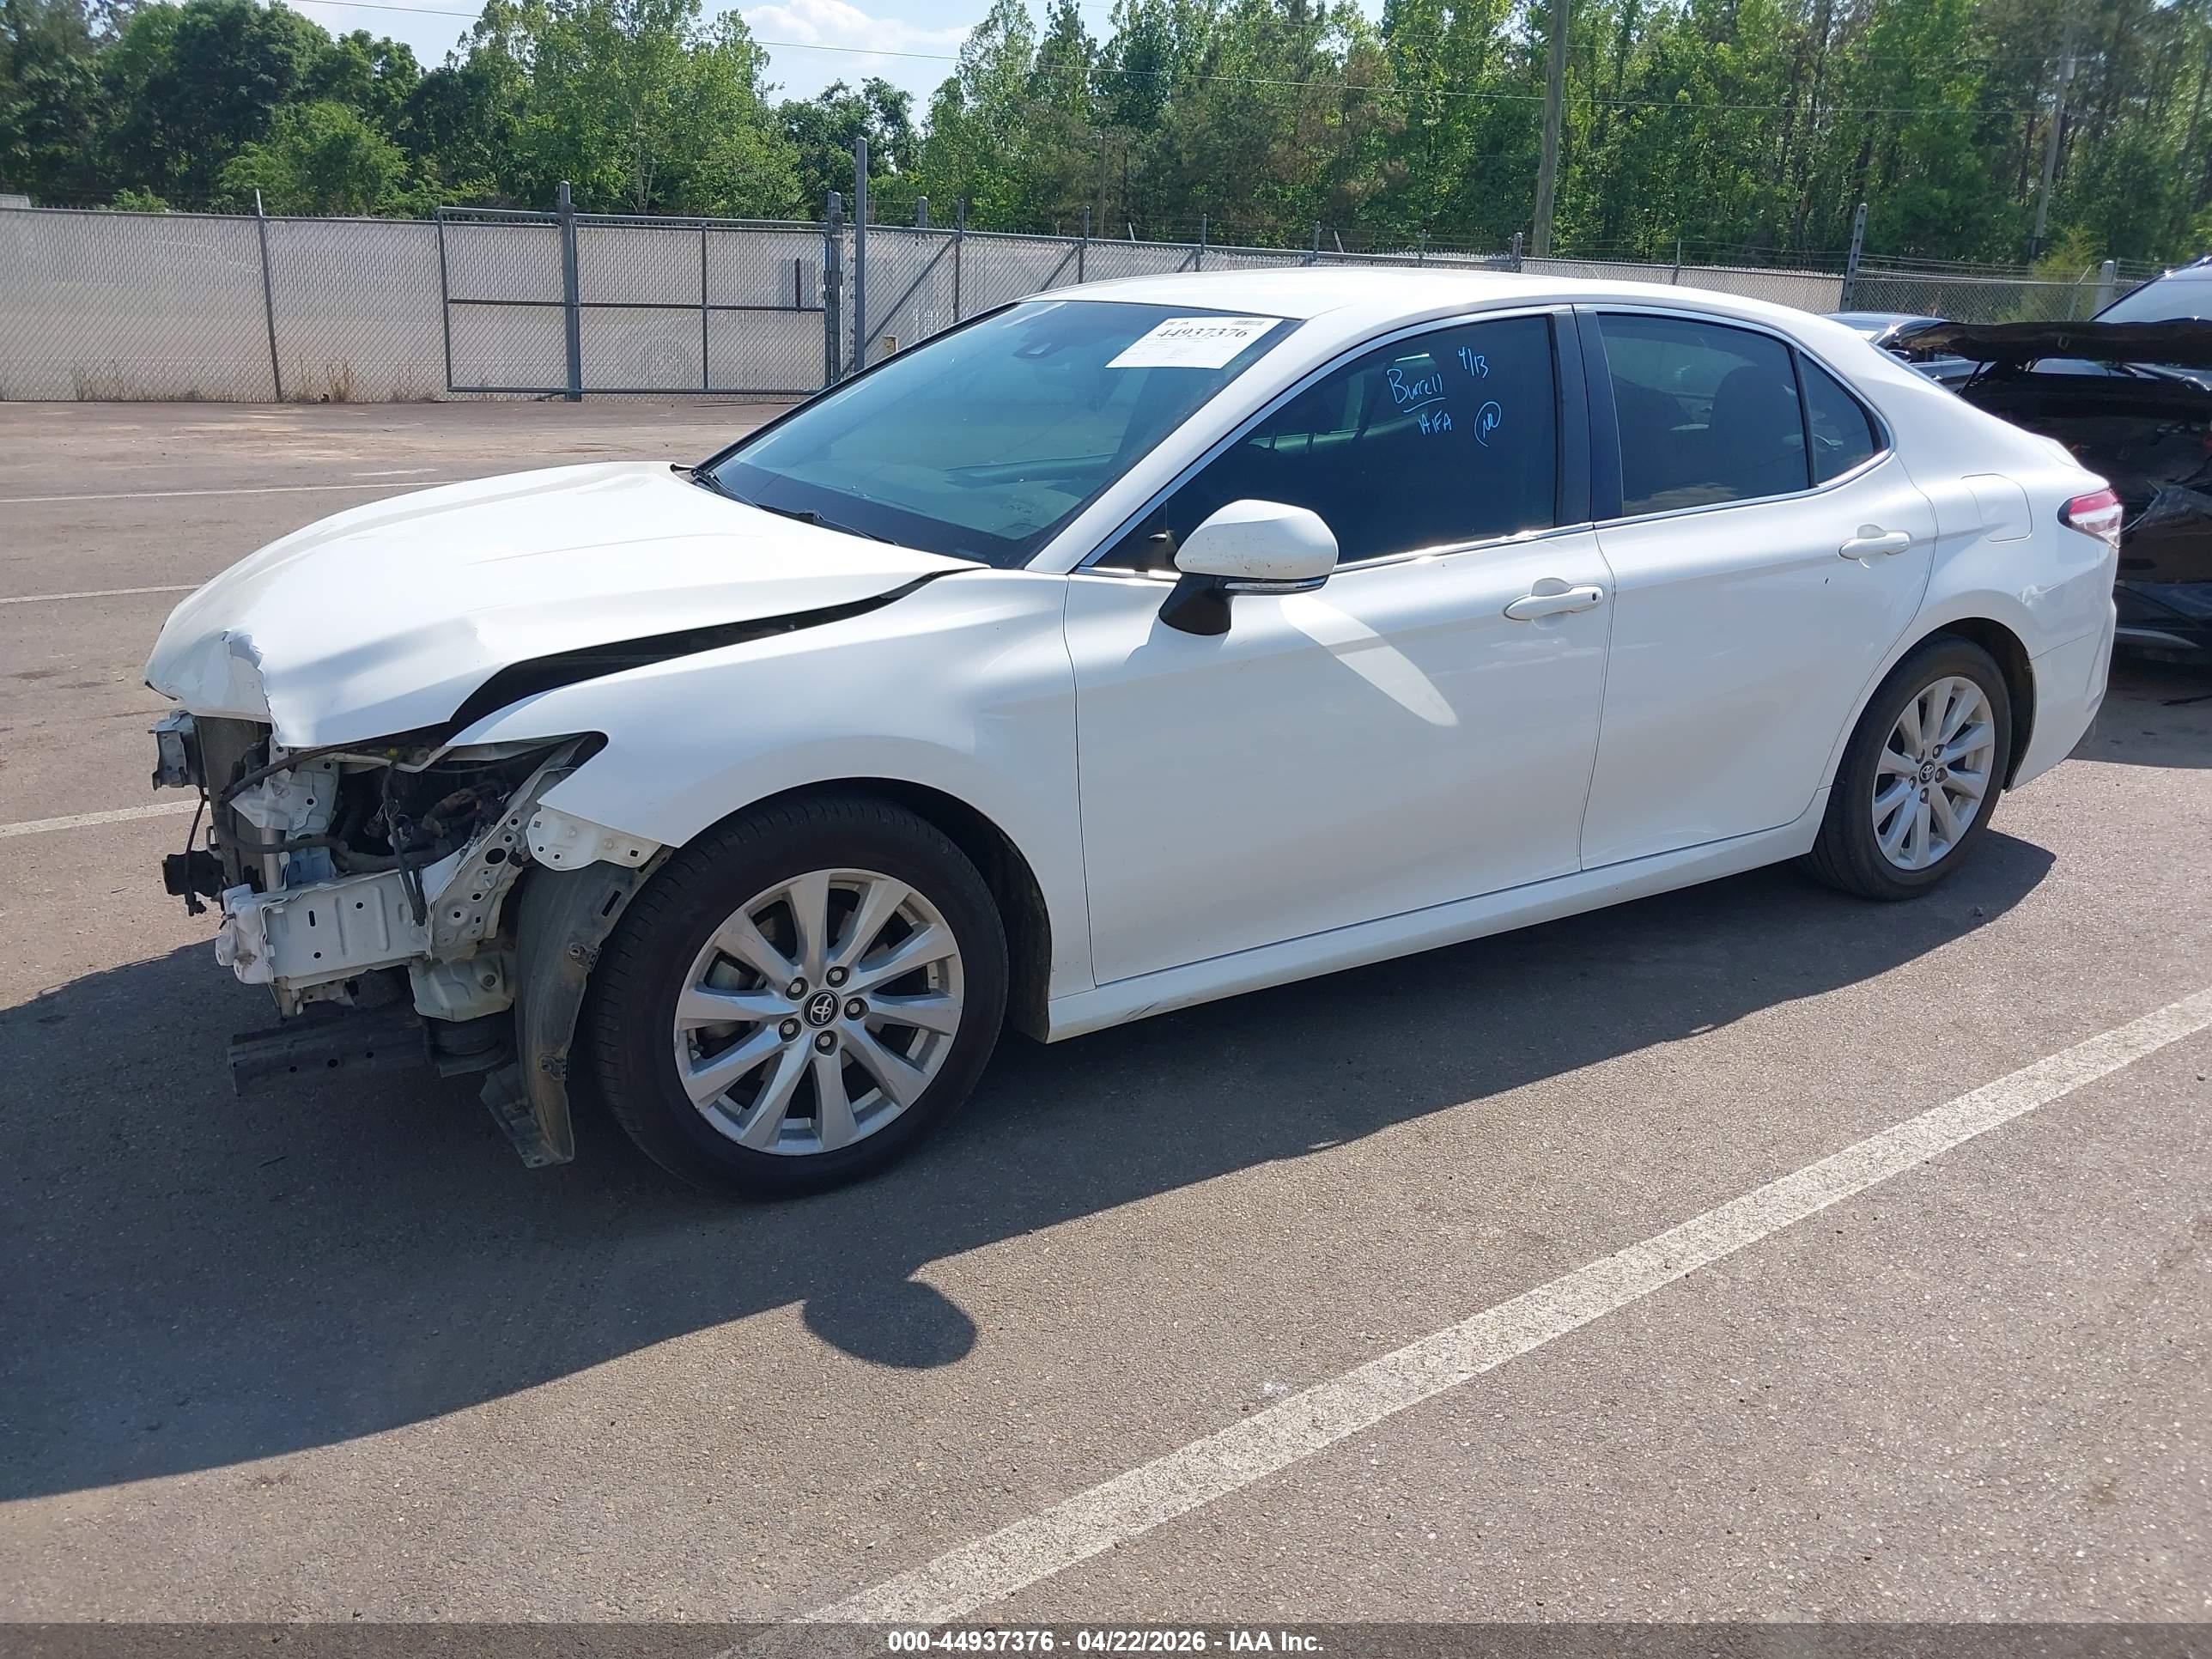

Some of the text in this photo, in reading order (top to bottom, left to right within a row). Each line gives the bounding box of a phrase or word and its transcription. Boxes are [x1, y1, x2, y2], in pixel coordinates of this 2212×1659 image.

[1157, 328, 1250, 338] 44937376
[1458, 346, 1489, 379] 4/13
[1386, 368, 1443, 404] Burrell
